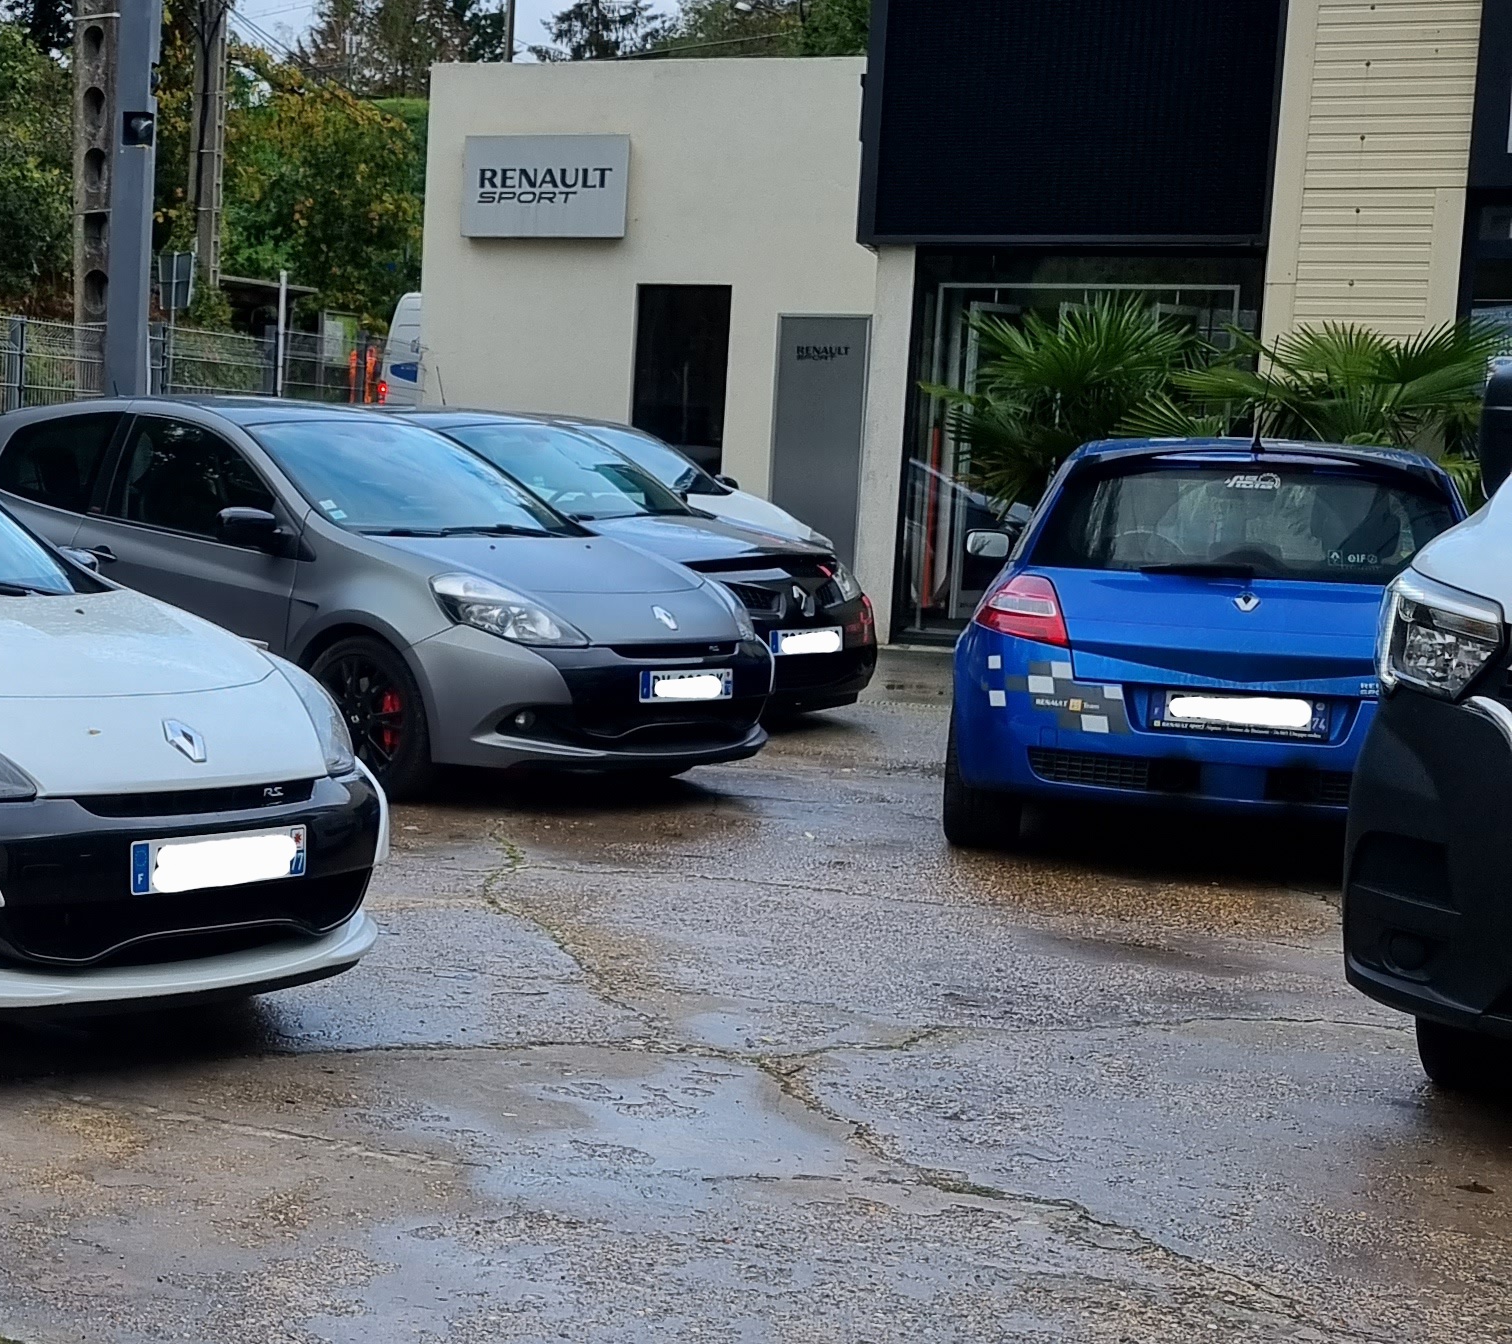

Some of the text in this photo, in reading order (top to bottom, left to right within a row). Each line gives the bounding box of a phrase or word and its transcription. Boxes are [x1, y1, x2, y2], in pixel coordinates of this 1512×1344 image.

[478, 167, 613, 189] RENAULT
[477, 191, 578, 204] SPORT
[796, 345, 850, 356] RENAULT
[1312, 717, 1326, 731] 74
[263, 787, 284, 797] RS
[137, 873, 144, 885] F
